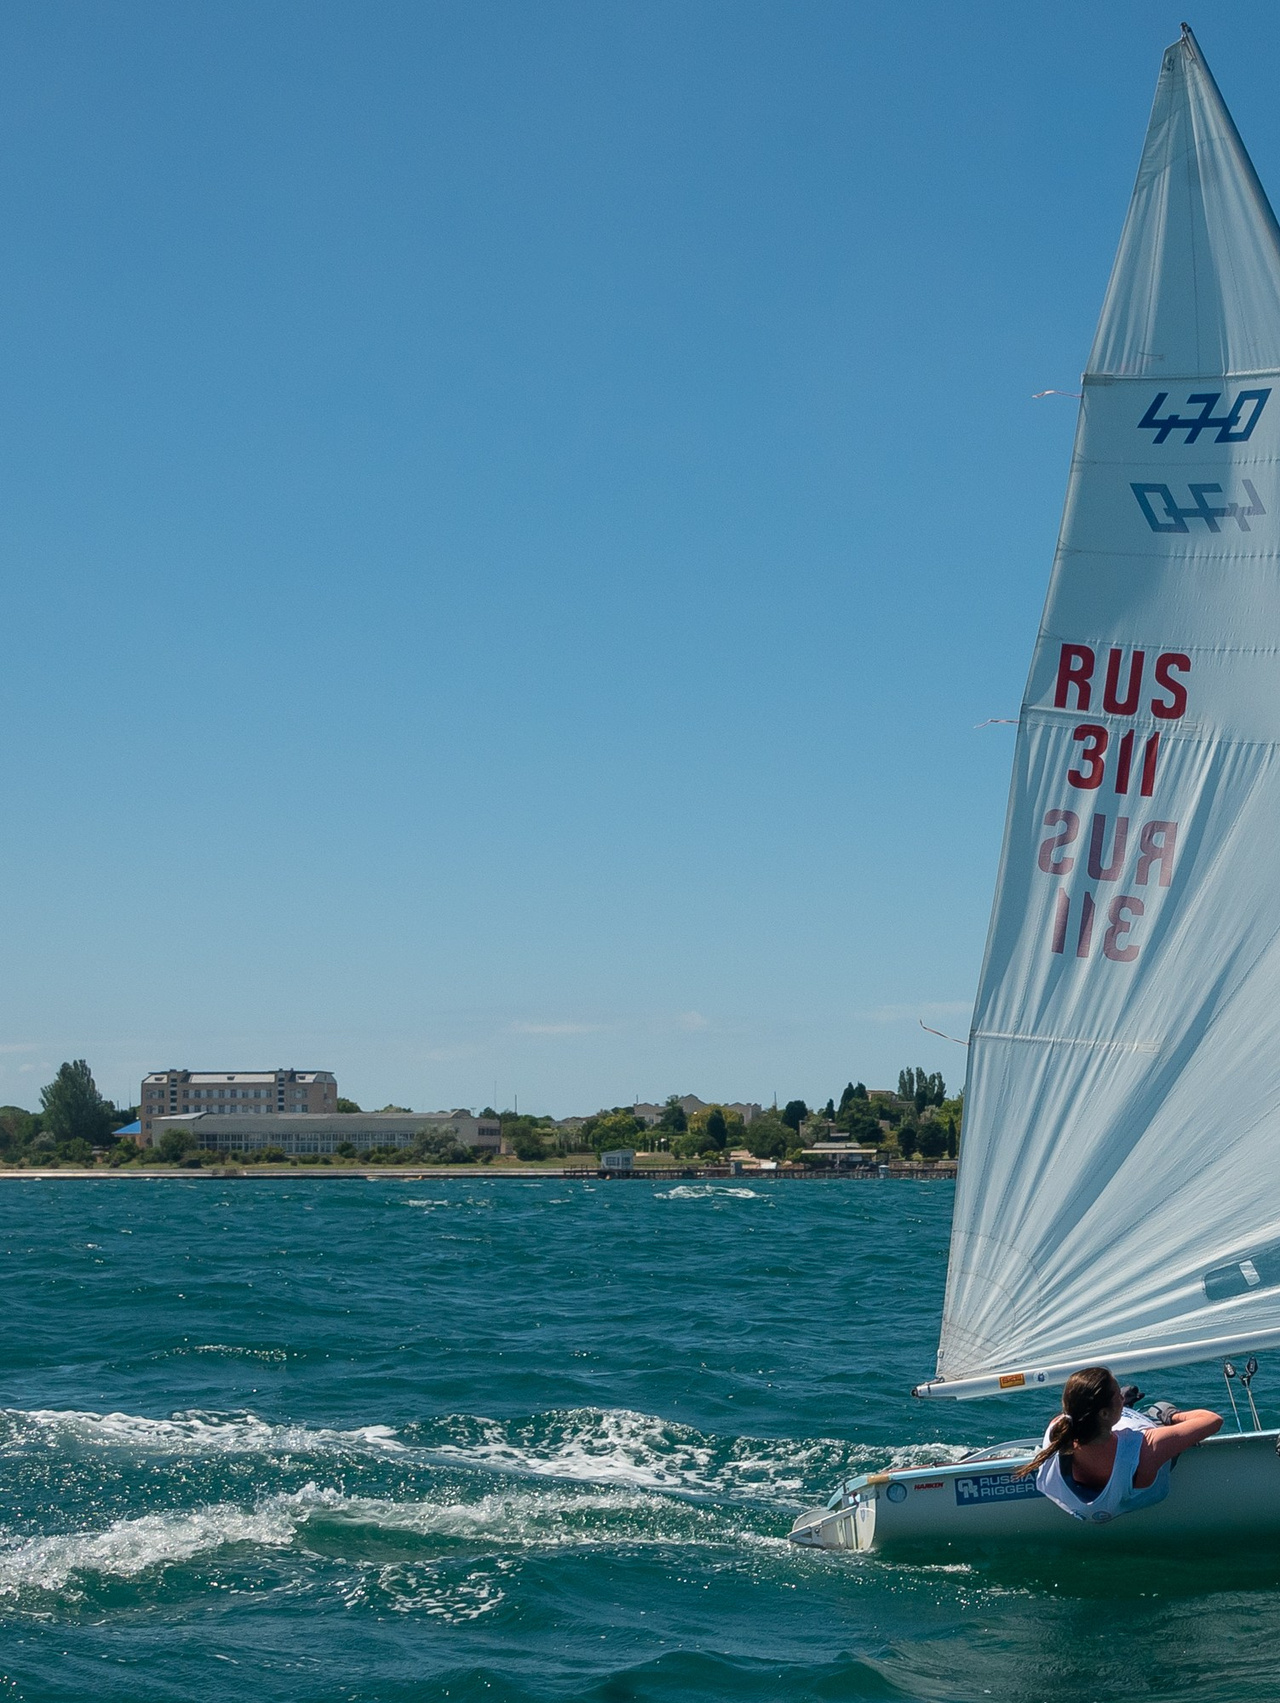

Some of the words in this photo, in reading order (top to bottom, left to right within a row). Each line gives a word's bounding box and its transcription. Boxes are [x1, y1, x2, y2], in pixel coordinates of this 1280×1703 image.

[1137, 388, 1272, 444] 470
[1054, 643, 1191, 720] RUS
[1067, 724, 1161, 797] 311
[914, 1482, 944, 1490] HARKEN
[980, 1472, 1038, 1487] RUSSIA
